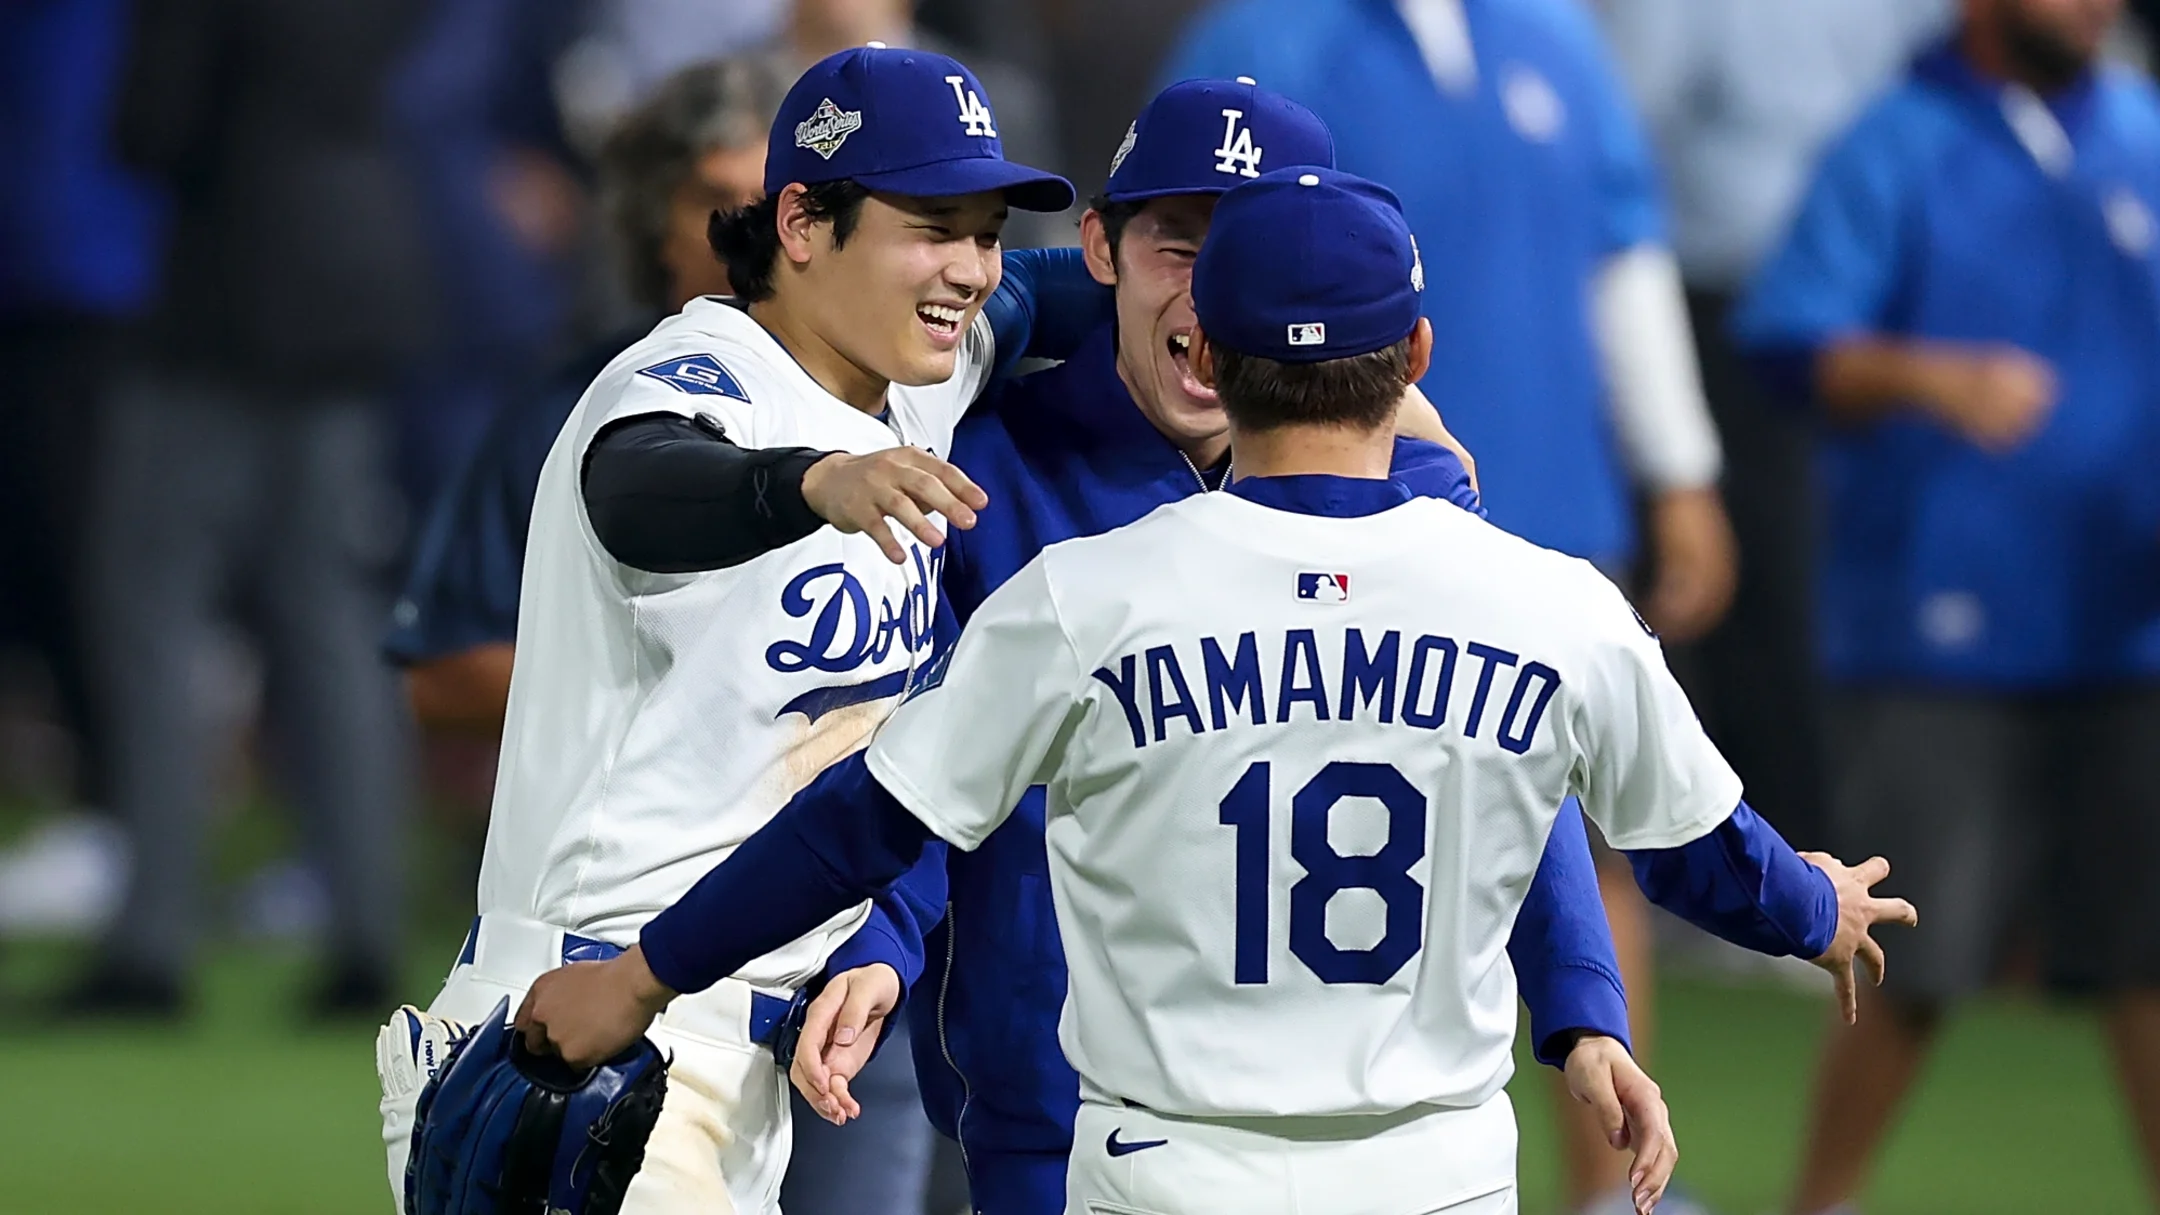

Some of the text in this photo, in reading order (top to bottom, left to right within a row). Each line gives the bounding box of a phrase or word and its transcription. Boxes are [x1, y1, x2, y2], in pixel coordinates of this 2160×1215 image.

[797, 112, 859, 143] World Series
[945, 76, 997, 138] LA
[1214, 109, 1262, 178] LA
[1090, 627, 1562, 755] YAMAMOTO
[1218, 761, 1428, 985] 18
[425, 1040, 434, 1067] new
